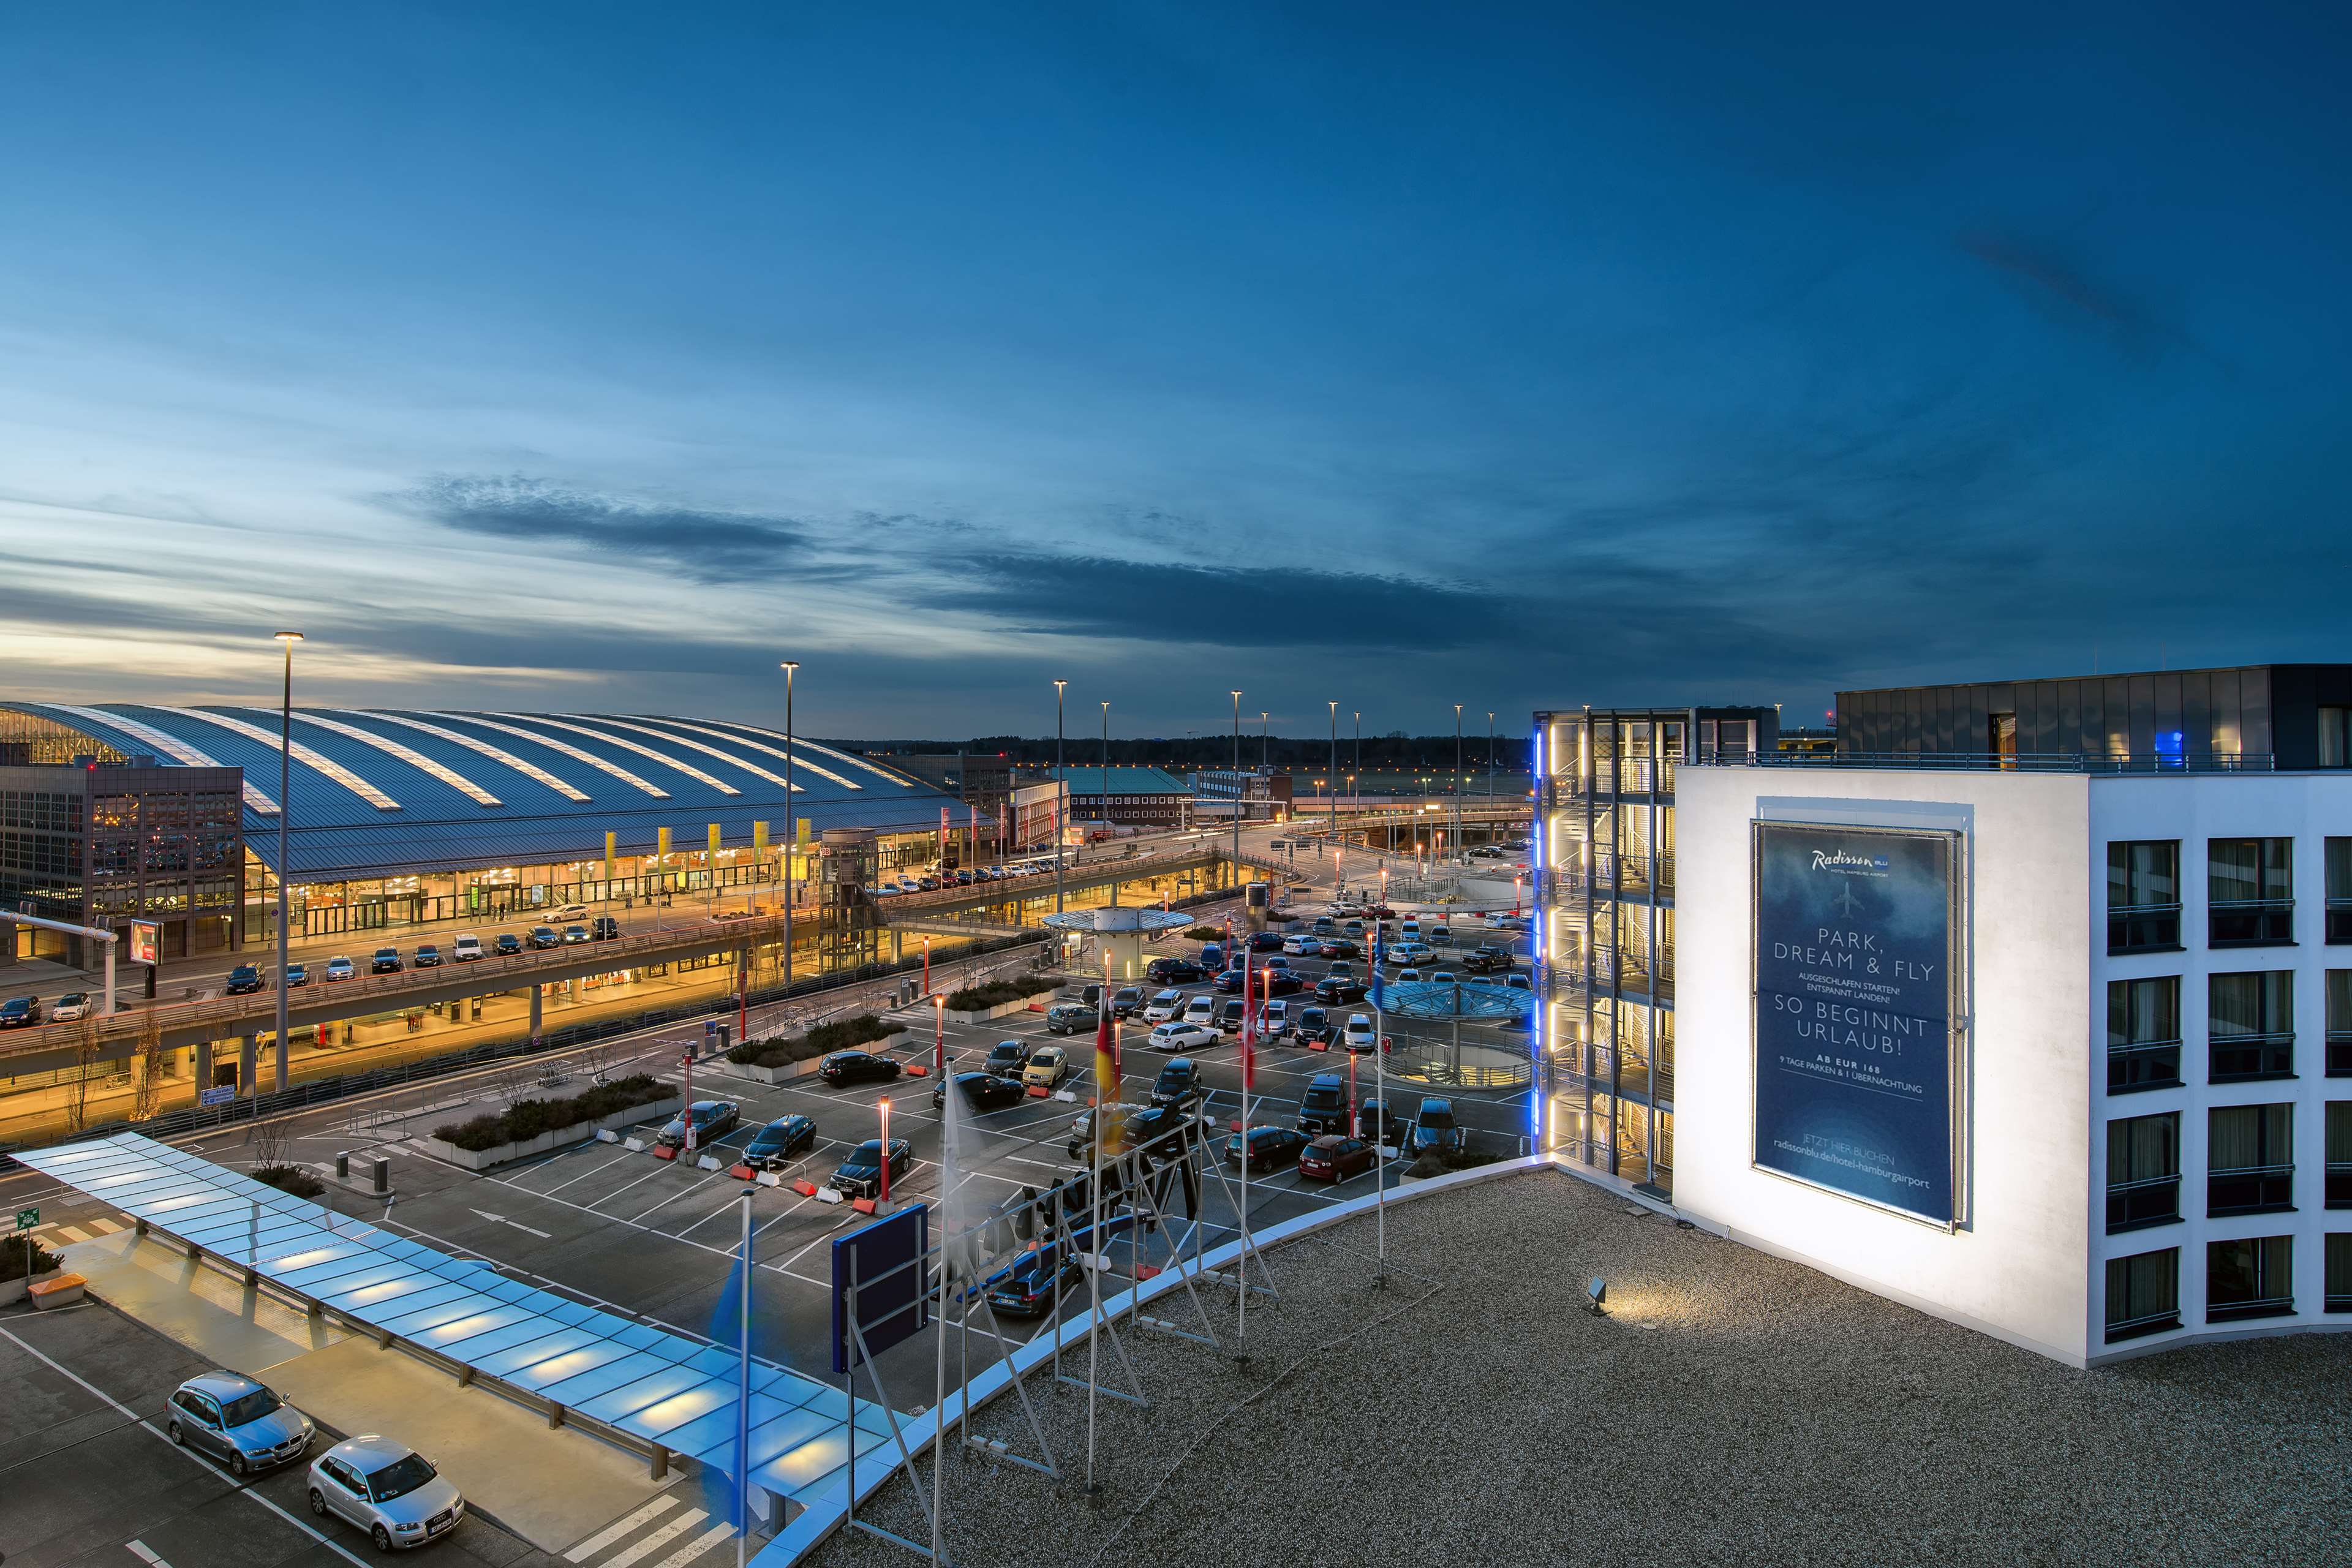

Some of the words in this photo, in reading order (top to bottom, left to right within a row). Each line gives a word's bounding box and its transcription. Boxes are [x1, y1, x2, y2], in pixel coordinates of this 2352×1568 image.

[1812, 849, 1872, 870] Radisson
[1819, 928, 1883, 954] PARK,
[1774, 943, 1852, 970] DREAM
[1867, 957, 1880, 974] &
[1895, 960, 1934, 981] FLY
[1798, 972, 1861, 989] AUSGESCHLAFEN
[1863, 982, 1900, 995] STARTEN!
[1807, 984, 1852, 998] ENTSPANNT
[1853, 991, 1890, 1004] LANDEN!
[1774, 994, 1803, 1014] SO
[1817, 1001, 1928, 1036] BEGINNT
[1798, 1019, 1901, 1055] URLAUB!
[1786, 1057, 1805, 1068] TAGE
[1806, 1061, 1836, 1075] PARKEN
[1852, 1070, 1923, 1094] ÜBERNACHTUNG
[1817, 1054, 1831, 1063] AB
[1836, 1058, 1858, 1069] EUR
[1863, 1064, 1880, 1074] 168
[1774, 1139, 1931, 1189] radissonblu.de/hotel-hamburgairport
[1803, 1133, 1828, 1147] JETZT
[1831, 1140, 1851, 1153] HIER
[1853, 1147, 1895, 1166] BUCHEN
